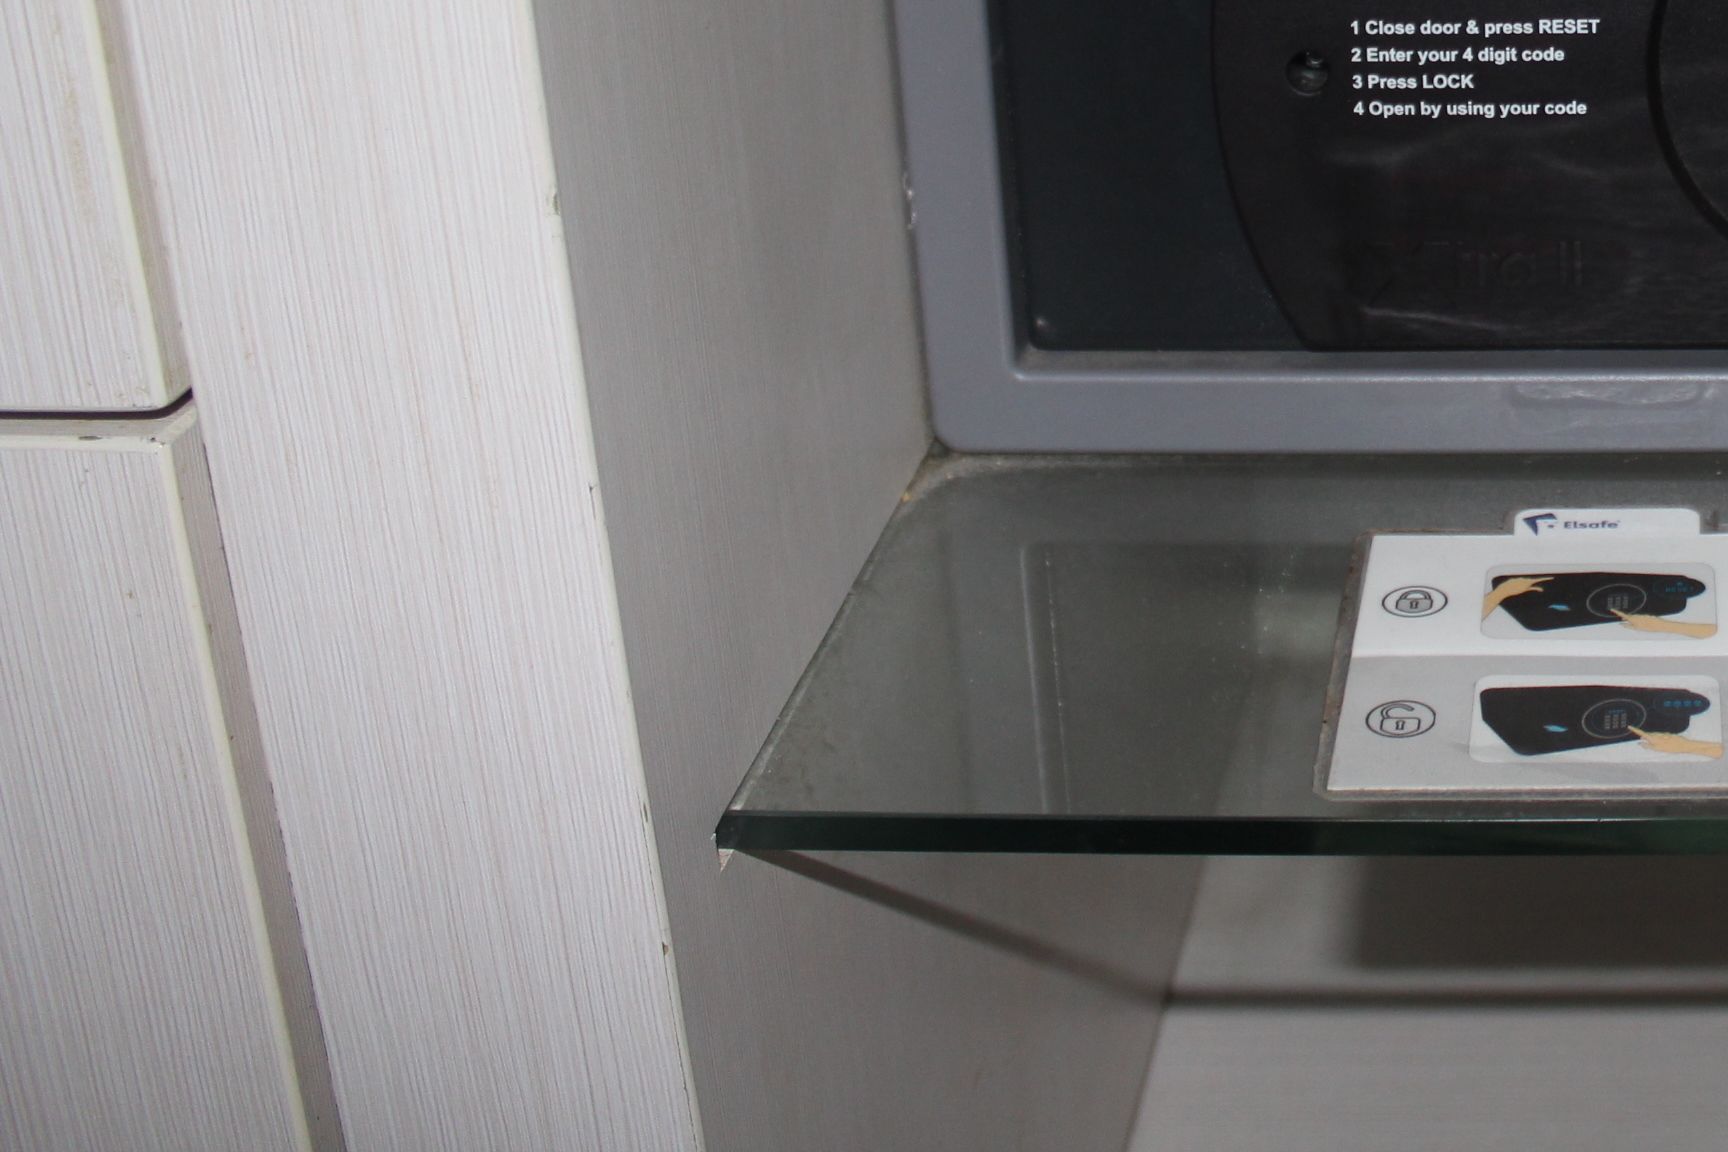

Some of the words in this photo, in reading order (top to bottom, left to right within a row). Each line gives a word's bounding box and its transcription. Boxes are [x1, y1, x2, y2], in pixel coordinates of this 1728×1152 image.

[1351, 21, 1358, 34] 1
[1365, 20, 1415, 34] Close
[1420, 20, 1461, 34] door
[1466, 20, 1479, 34] &
[1485, 23, 1533, 38] press
[1539, 19, 1600, 34] RESET
[1351, 48, 1361, 62] 2
[1367, 47, 1413, 62] Enter
[1418, 50, 1458, 65] your
[1462, 47, 1473, 61] 4
[1478, 47, 1517, 65] digit
[1522, 47, 1564, 61] code
[1352, 75, 1362, 89] 3
[1368, 74, 1417, 89] Press
[1423, 74, 1474, 88] LOCK
[1354, 101, 1364, 115] 4
[1369, 101, 1415, 118] Open
[1420, 101, 1441, 118] by
[1447, 101, 1495, 118] using
[1500, 104, 1540, 118] your
[1545, 101, 1587, 114] code
